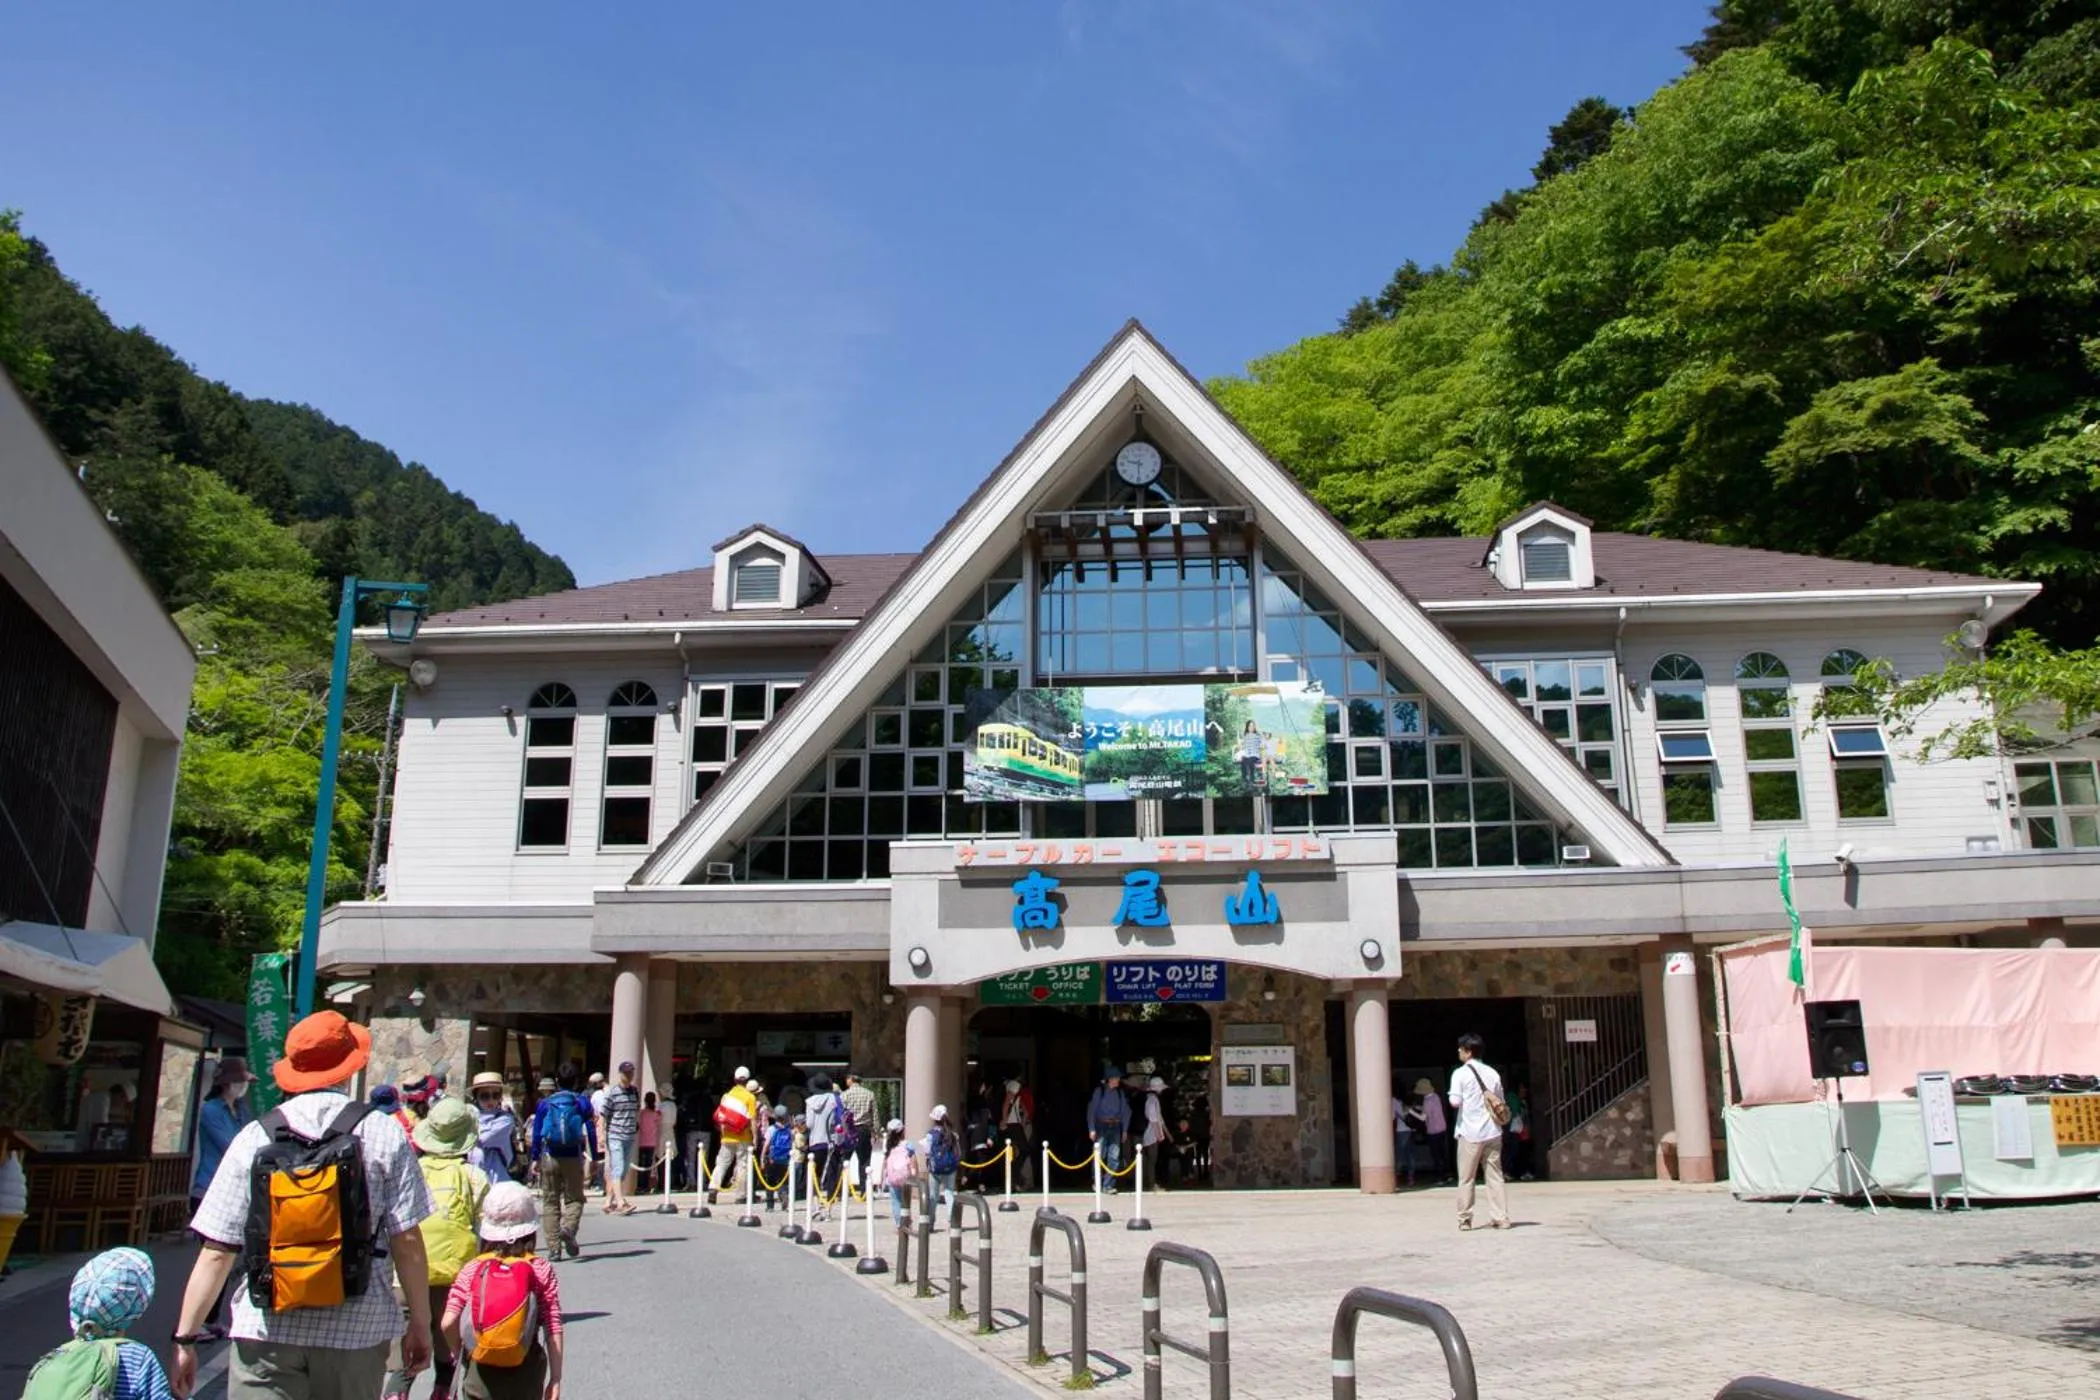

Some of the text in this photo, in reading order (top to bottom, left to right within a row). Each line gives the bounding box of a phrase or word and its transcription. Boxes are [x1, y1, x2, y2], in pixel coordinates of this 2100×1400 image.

[1098, 741, 1137, 750] Welcome
[1138, 741, 1147, 750] to
[1045, 965, 1091, 980] うりば
[1112, 964, 1218, 982] リフト のりば
[1000, 982, 1083, 990] TICKET OFFICE
